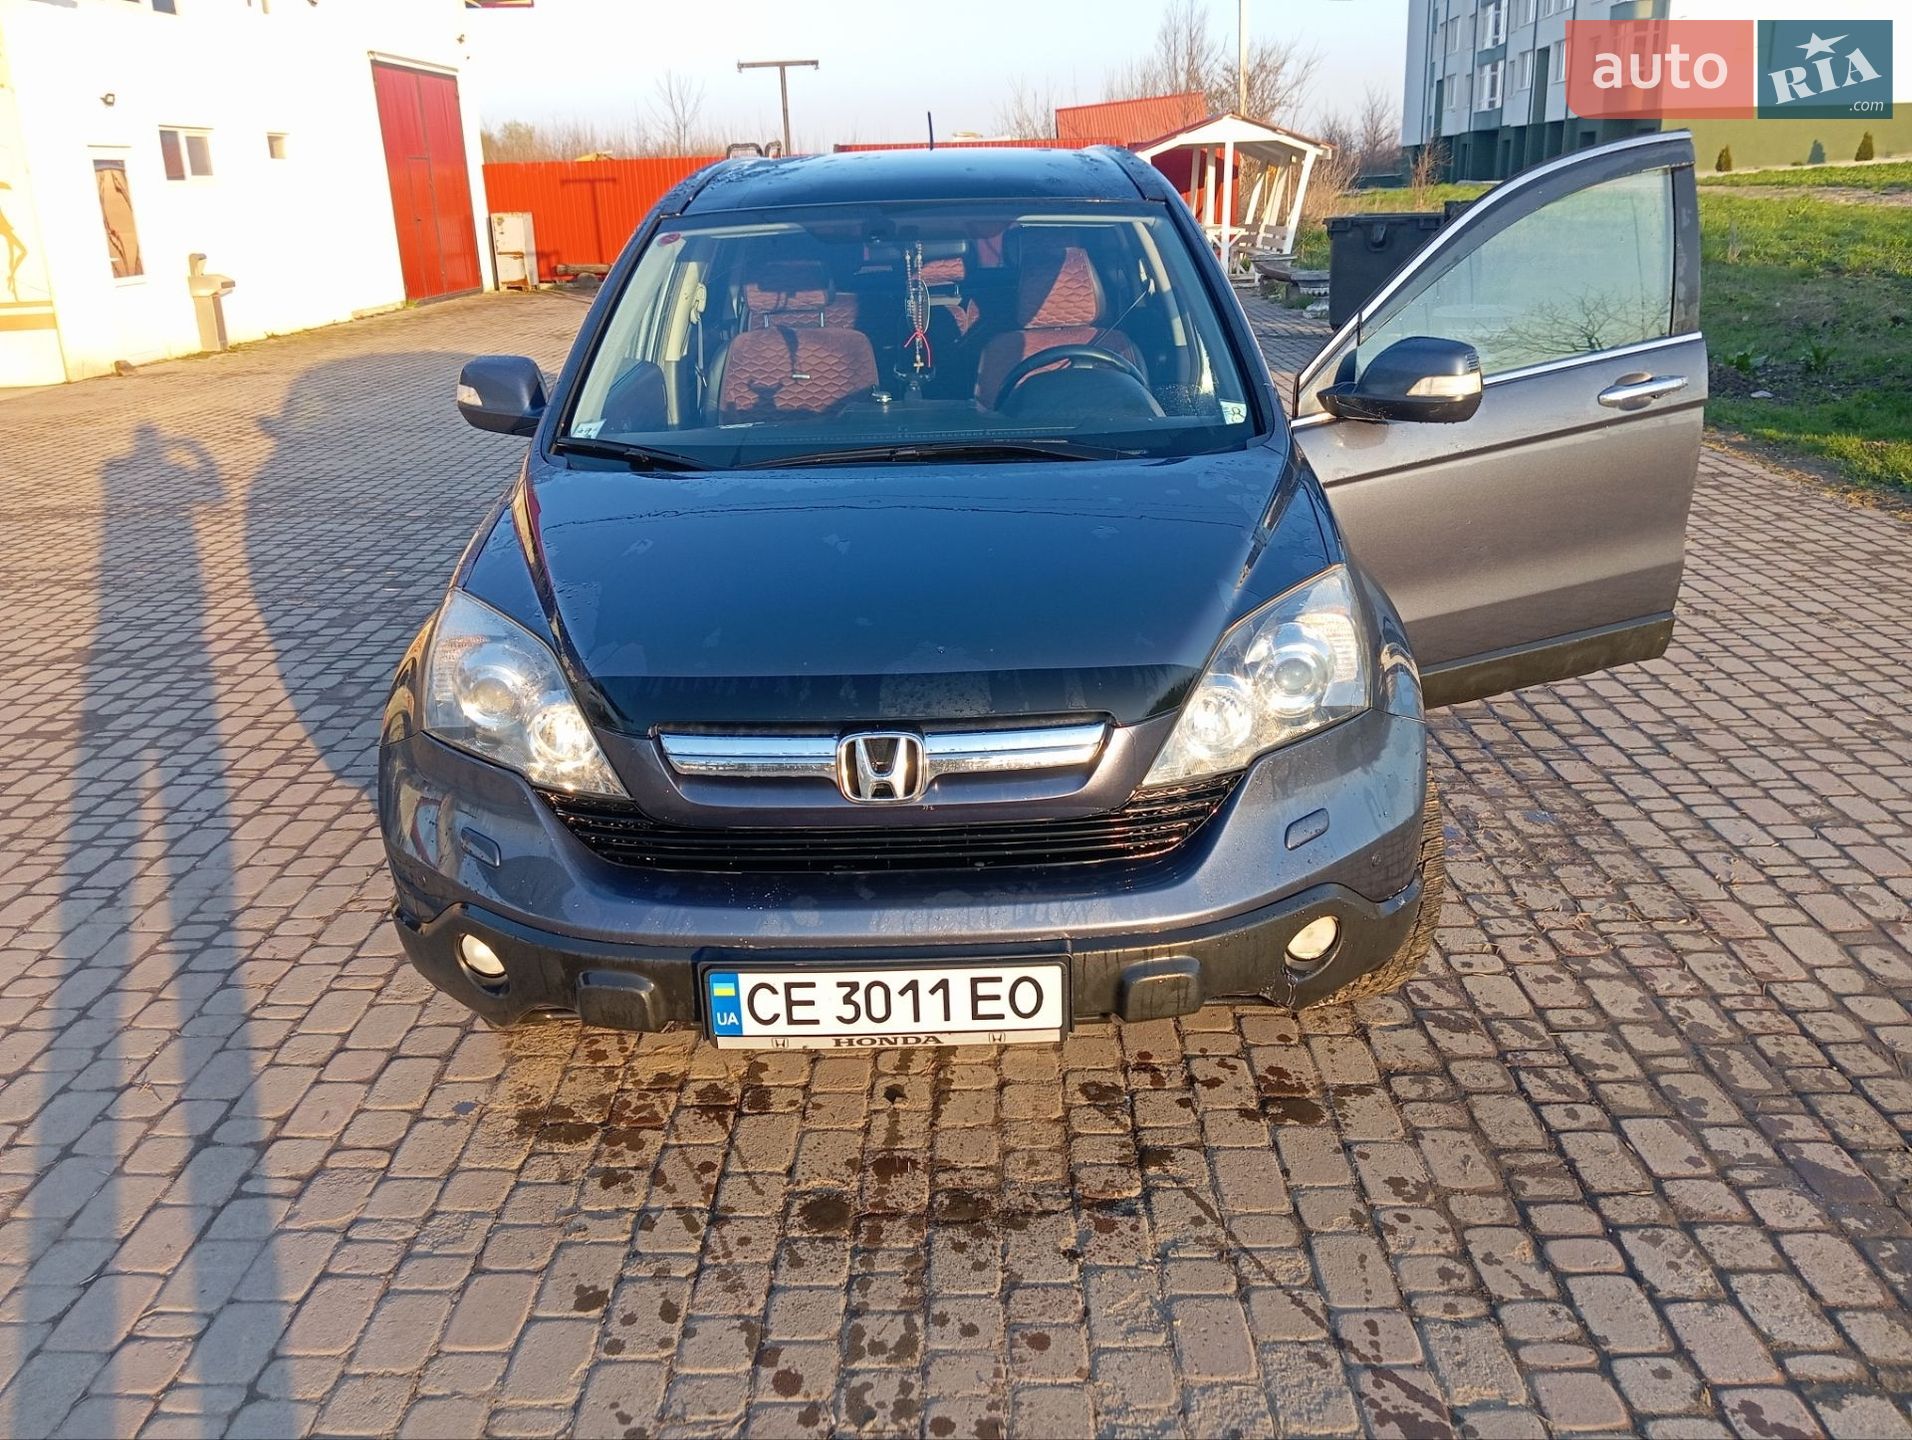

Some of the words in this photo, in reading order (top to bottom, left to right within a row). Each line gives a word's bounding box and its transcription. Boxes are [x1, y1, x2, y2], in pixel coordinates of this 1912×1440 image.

[746, 981, 820, 1026] CE
[835, 977, 951, 1025] 3011
[969, 975, 1044, 1021] EO
[716, 1012, 740, 1026] UA
[832, 1035, 944, 1047] HONDA
